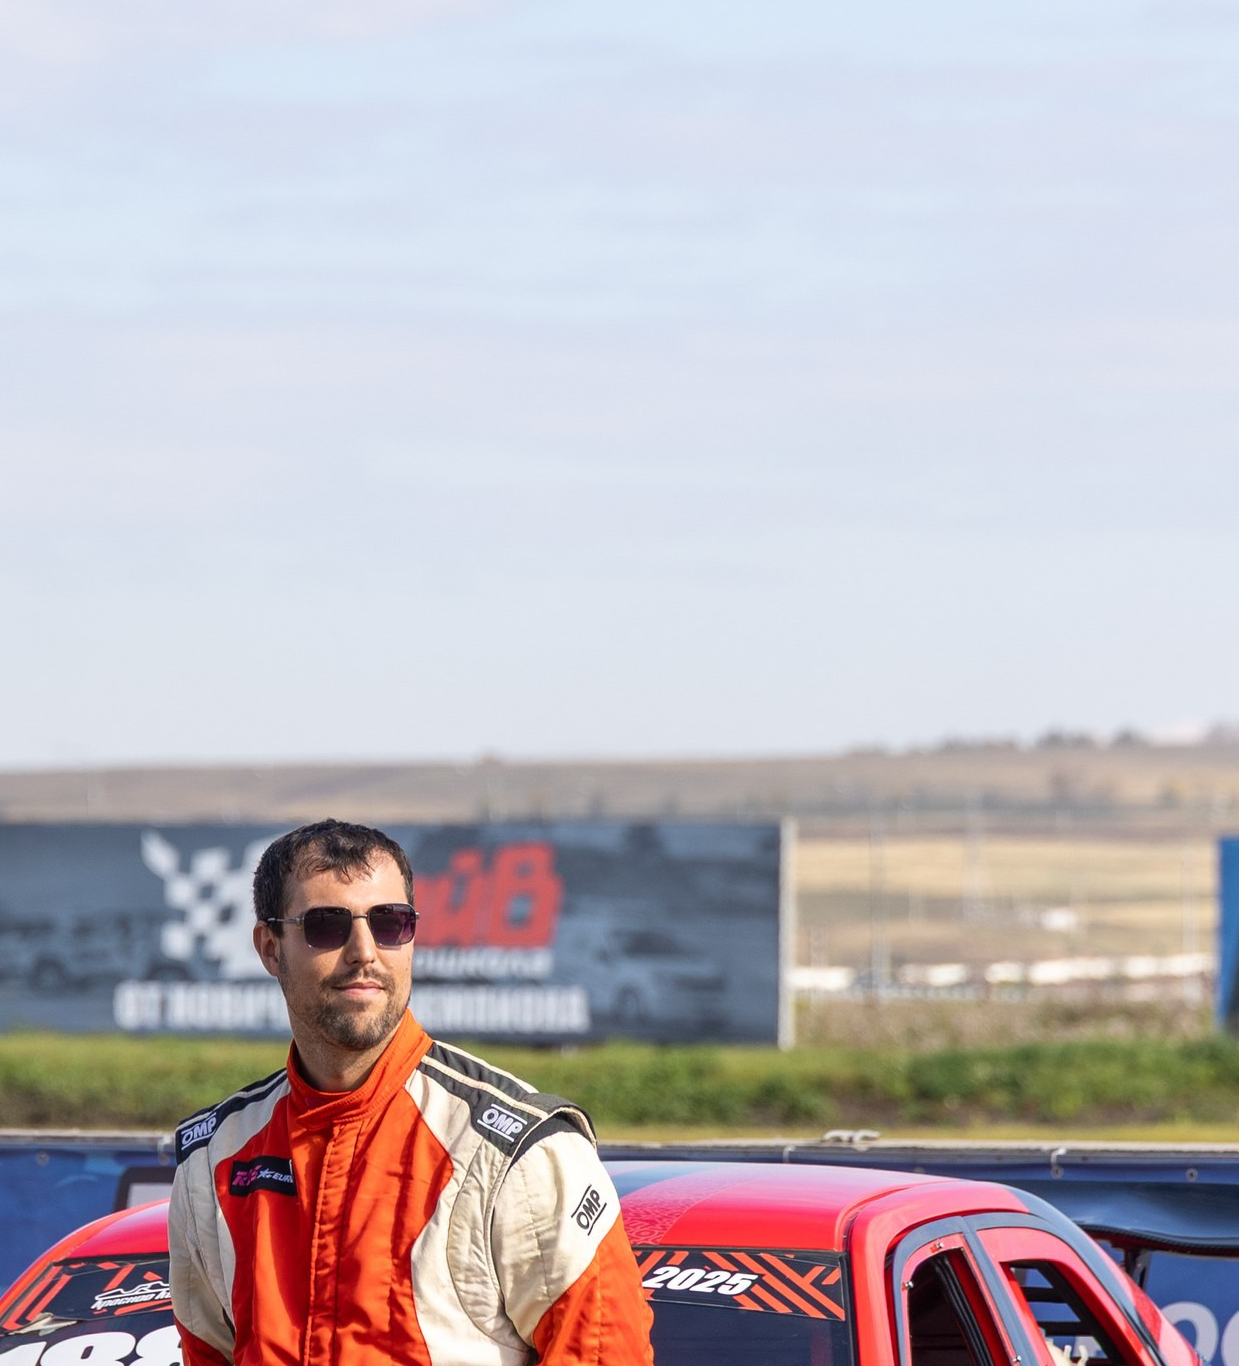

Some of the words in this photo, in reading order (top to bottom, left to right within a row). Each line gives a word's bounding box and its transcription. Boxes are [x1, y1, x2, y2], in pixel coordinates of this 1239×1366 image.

[181, 1115, 217, 1146] OMP
[481, 1106, 524, 1136] OMP
[575, 1188, 602, 1231] OMP
[641, 1265, 758, 1296] 2025
